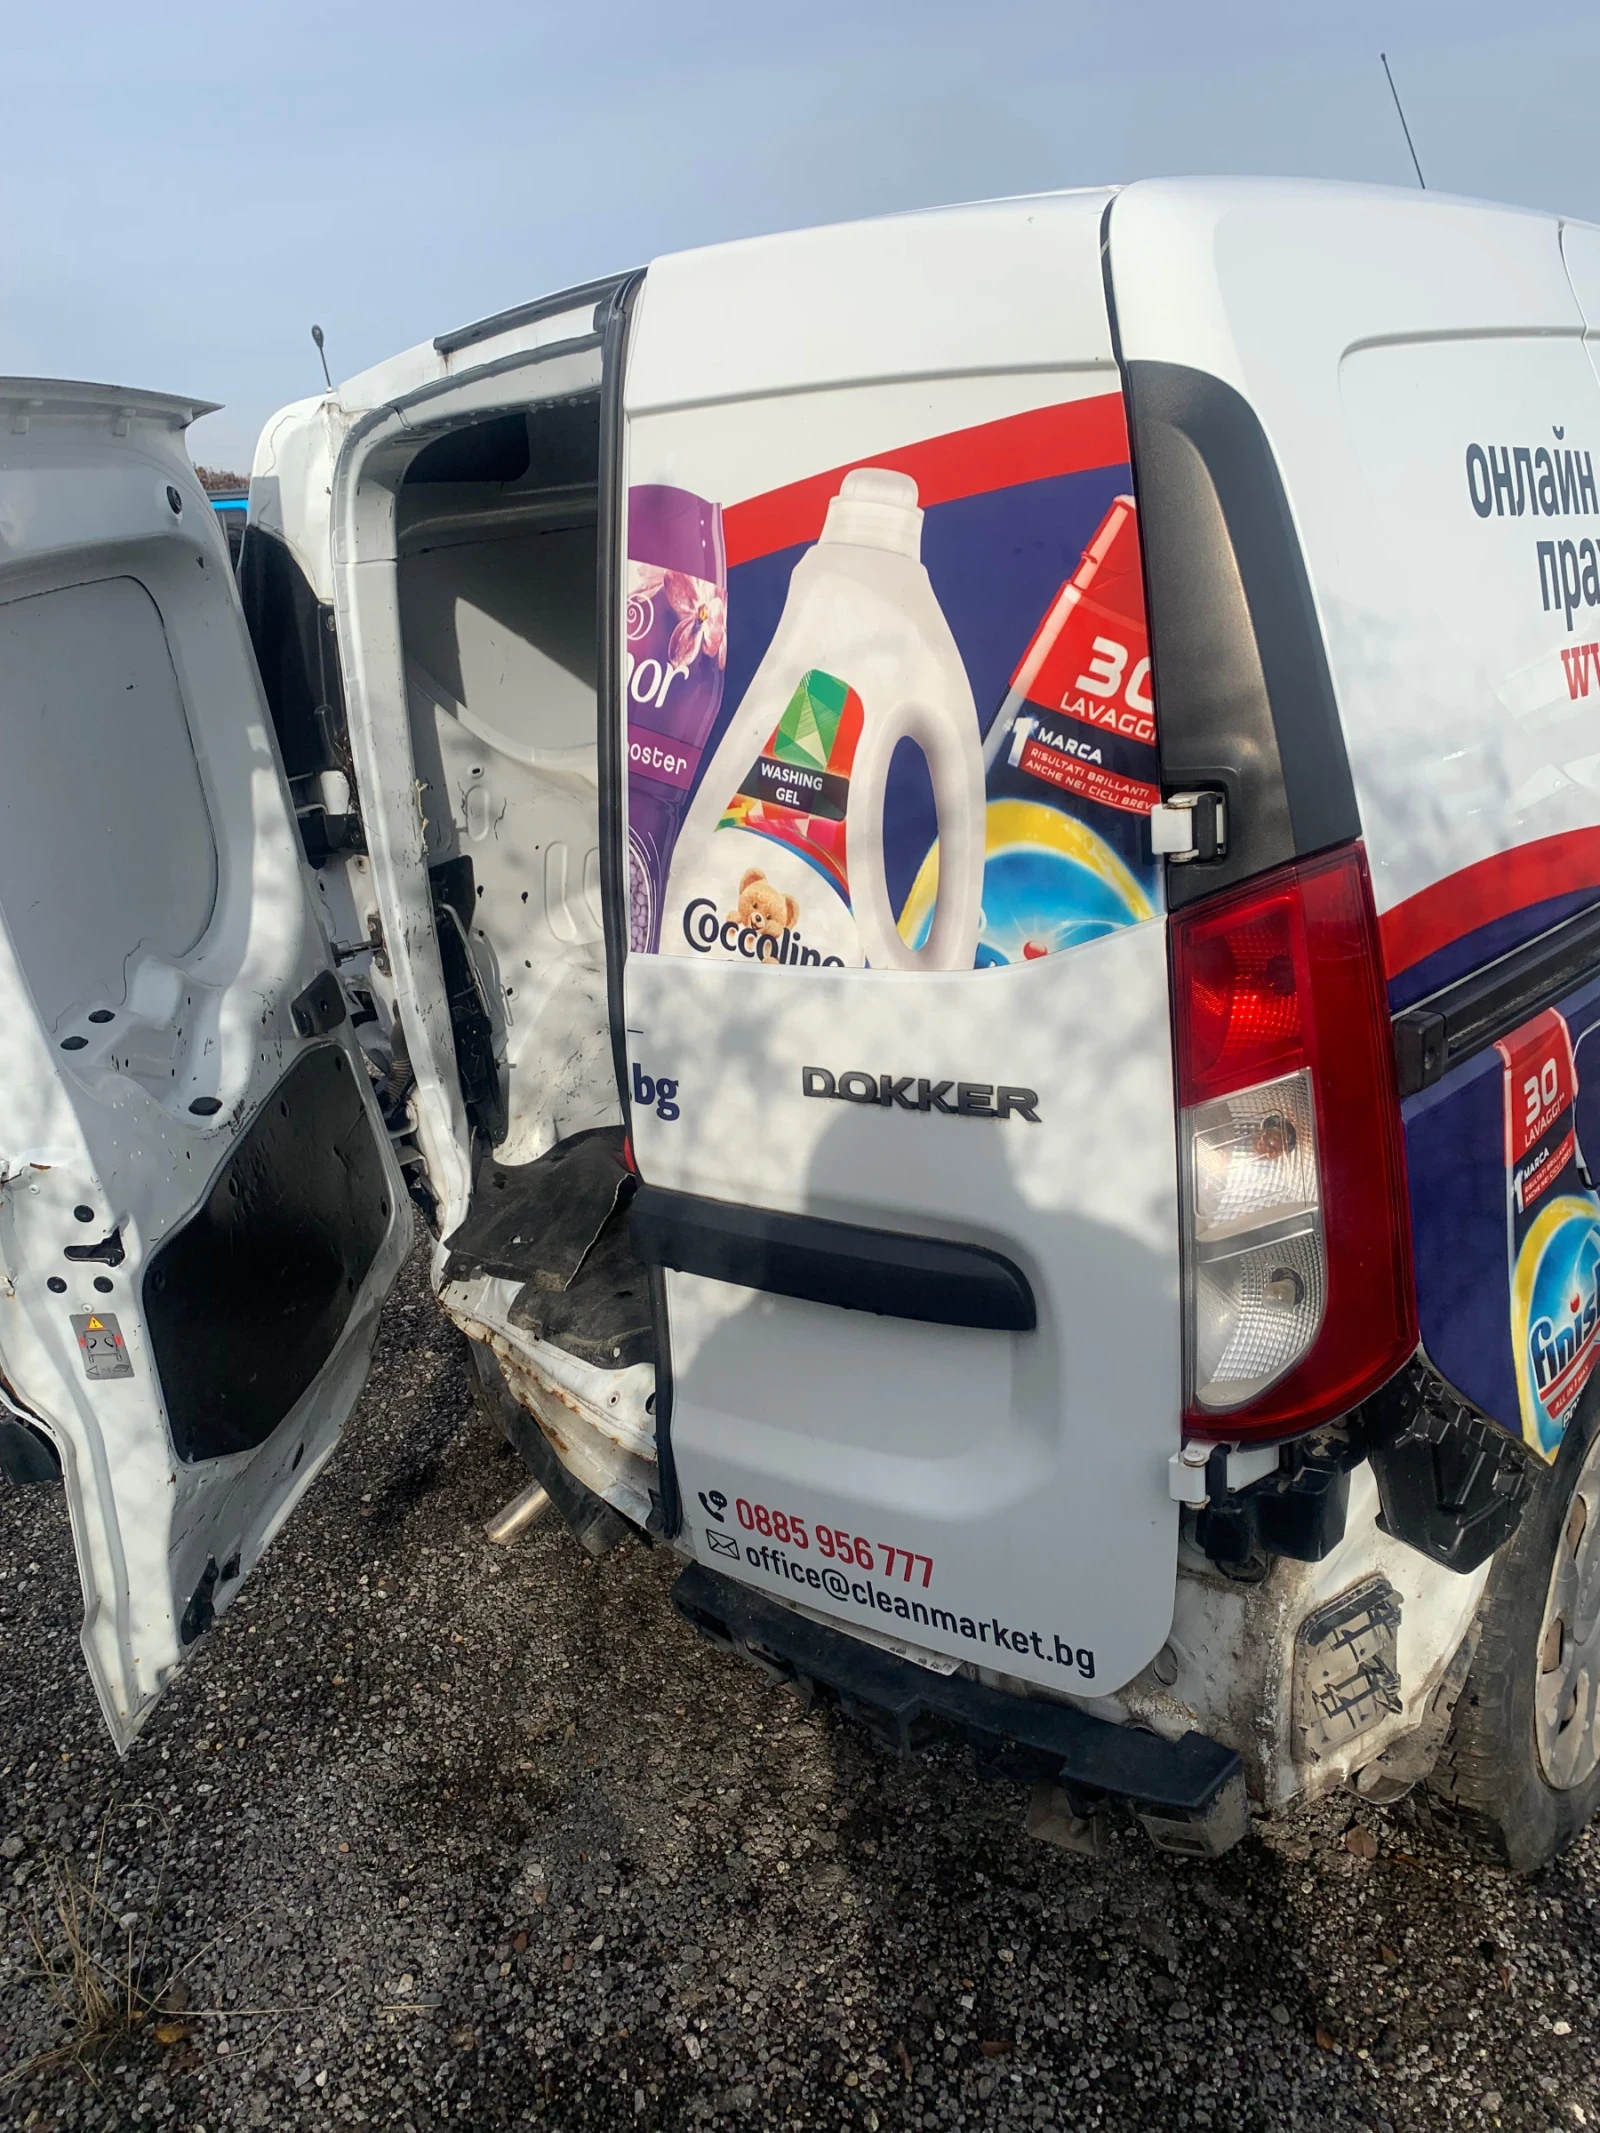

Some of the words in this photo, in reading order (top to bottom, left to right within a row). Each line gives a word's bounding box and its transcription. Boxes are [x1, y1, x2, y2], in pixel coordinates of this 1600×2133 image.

[1466, 425, 1600, 518] онлайн
[1536, 538, 1600, 631] пра
[627, 652, 690, 708] or
[627, 742, 688, 775] oster
[1031, 747, 1085, 777] RISULTATI
[1087, 767, 1149, 798] BRILLANTI
[1037, 727, 1102, 764] MARCA
[761, 762, 823, 791] WASHING
[775, 787, 800, 806] GEL
[1025, 759, 1063, 781] ANCHE
[1065, 776, 1086, 791] NEI
[1088, 784, 1120, 803] CICLI
[1121, 796, 1153, 811] BREV
[802, 1066, 1042, 1123] DOKKER
[1523, 1057, 1558, 1127] 30
[1523, 1147, 1550, 1180] MARCA
[1530, 1272, 1600, 1391] finis
[1555, 1394, 1567, 1411] ALL
[1566, 1384, 1574, 1398] IN
[735, 1498, 809, 1549] 0885
[815, 1524, 874, 1570] 956
[877, 1542, 934, 1588] 777
[746, 1544, 1097, 1679] office@cleanmarket.bg
